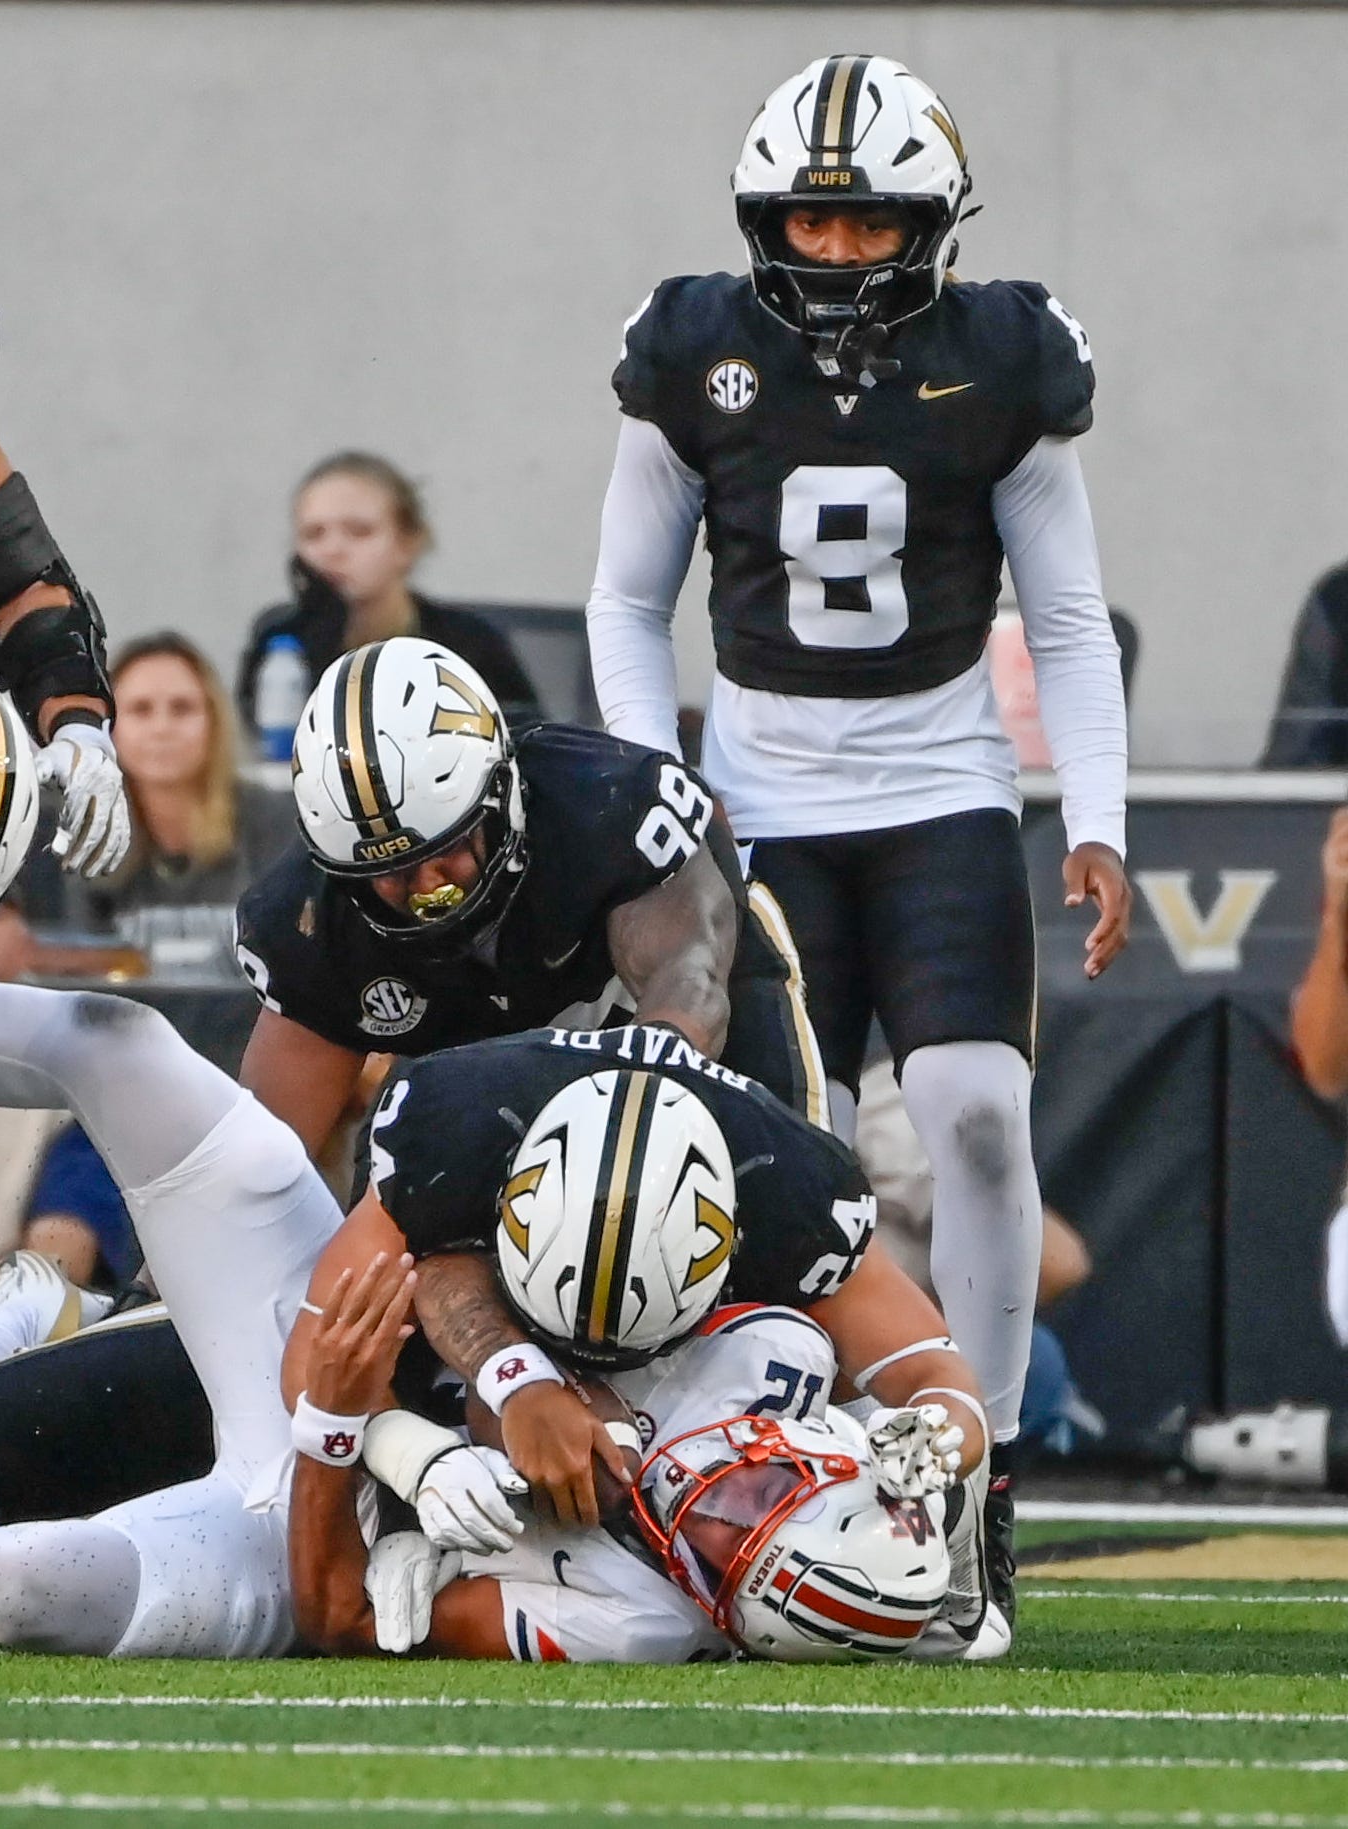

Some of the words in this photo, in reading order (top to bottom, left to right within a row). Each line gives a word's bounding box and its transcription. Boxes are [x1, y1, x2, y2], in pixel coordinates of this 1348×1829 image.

[807, 171, 852, 186] VUFB
[710, 363, 755, 410] SEC
[834, 394, 859, 416] V
[779, 464, 910, 649] 8
[429, 661, 497, 742] V
[635, 762, 715, 869] 99
[359, 835, 412, 862] VUFB
[1133, 870, 1278, 973] V
[365, 980, 412, 1021] SEC
[550, 1024, 752, 1092] RINALDI
[323, 1430, 356, 1459] AU
[748, 1544, 784, 1597] TIGERS
